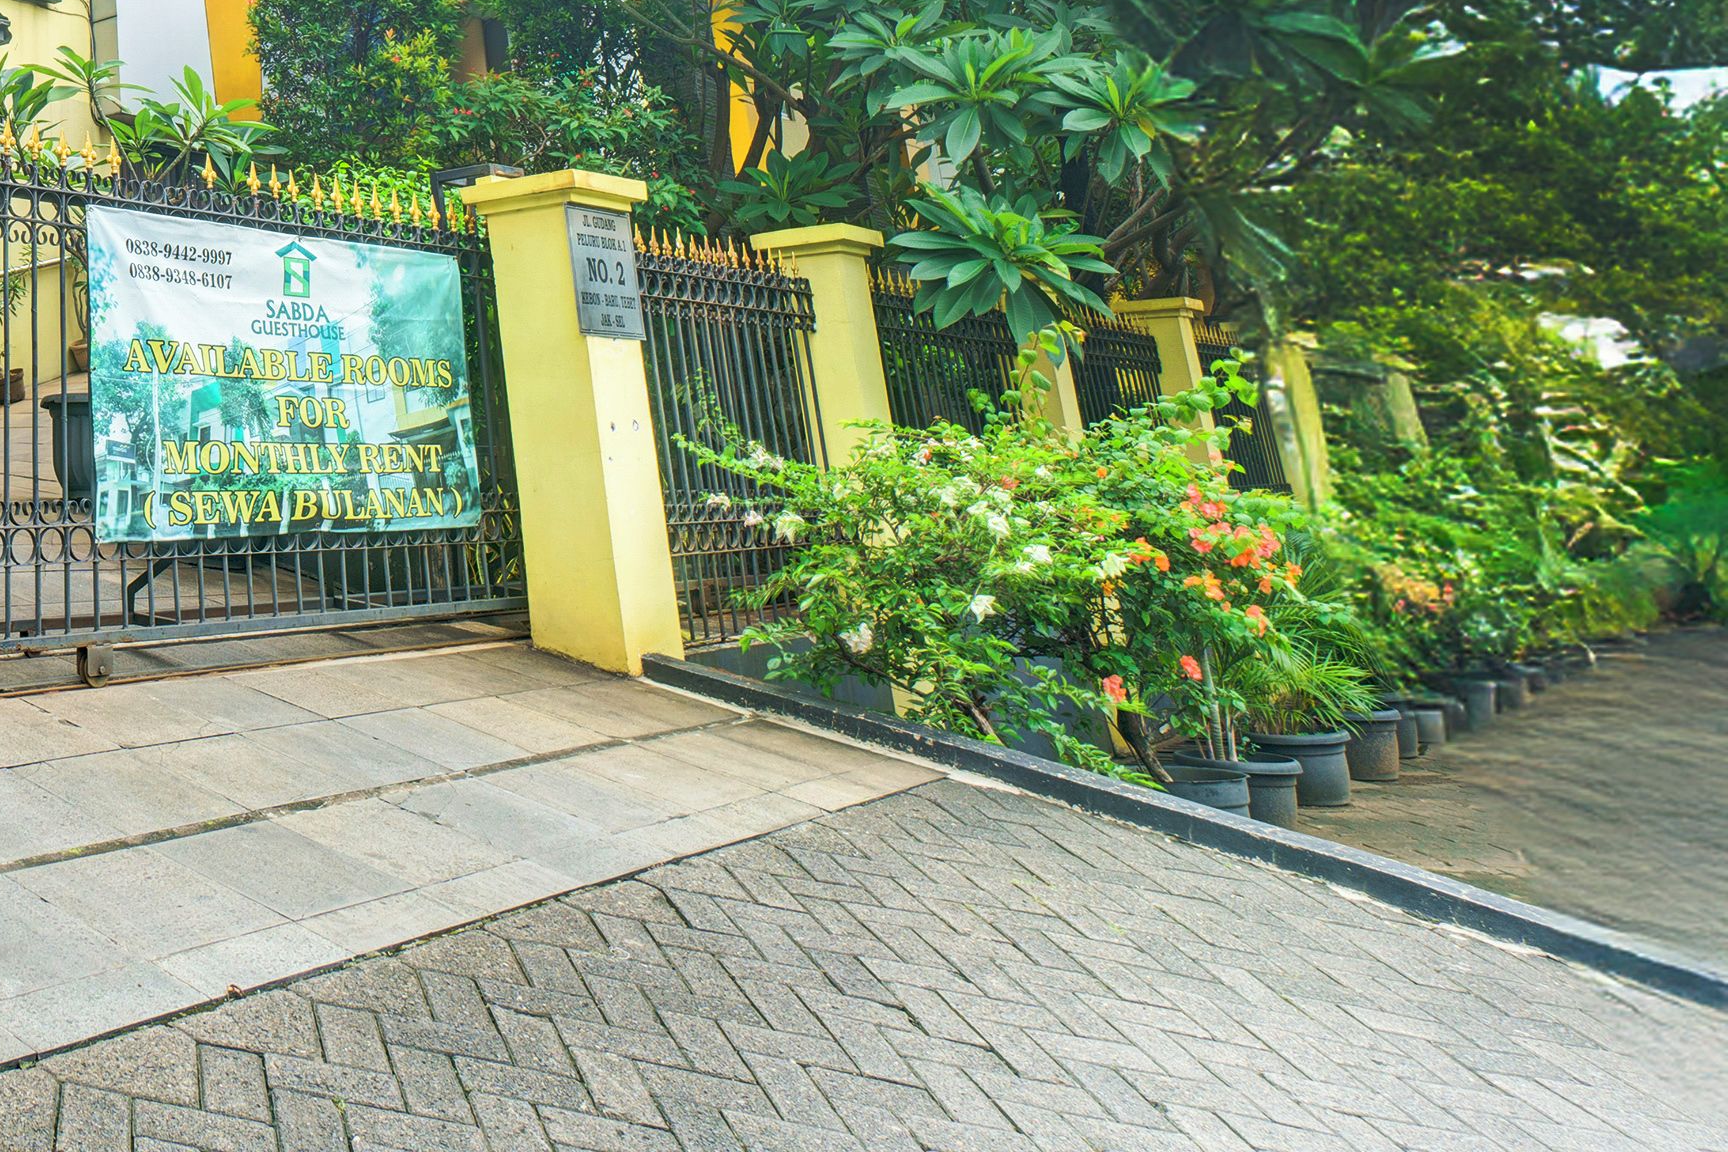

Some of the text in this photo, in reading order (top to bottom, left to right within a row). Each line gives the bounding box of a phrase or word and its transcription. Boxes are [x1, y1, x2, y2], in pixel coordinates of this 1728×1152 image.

[592, 216, 616, 232] GUDANG
[125, 238, 232, 265] 0838-9442-9997
[576, 233, 601, 248] PELURU
[600, 236, 618, 251] BLOK
[129, 262, 232, 290] 0838-9348-6107
[586, 257, 626, 286] NO. 2
[266, 299, 330, 323] SABDA
[581, 291, 601, 307] KEBON
[251, 319, 346, 342] GUESTHOUSE
[123, 338, 453, 389] AVAILABLE ROOMS
[275, 395, 350, 430] FOR
[162, 439, 442, 475] MONTHLY RENT
[168, 488, 283, 527] SEWA
[291, 486, 445, 523] BULANAN
